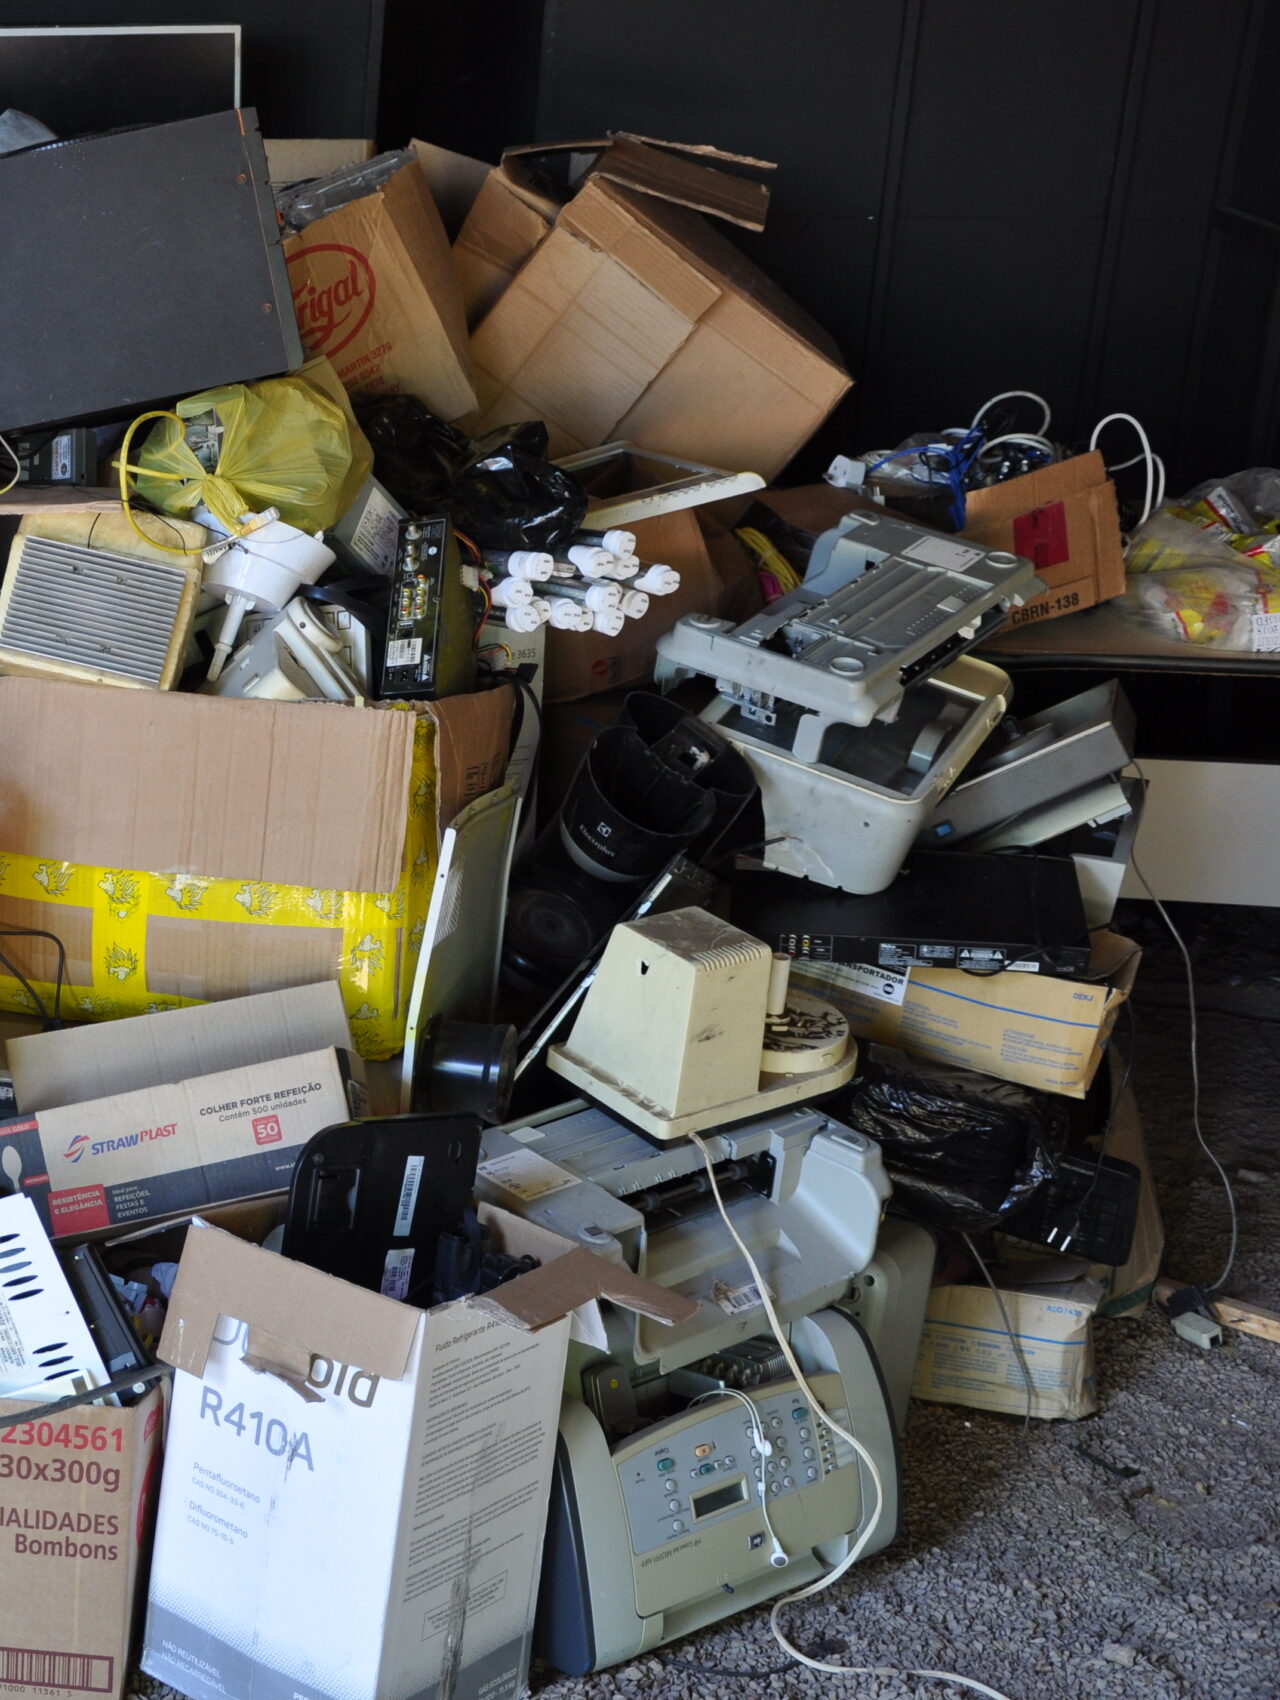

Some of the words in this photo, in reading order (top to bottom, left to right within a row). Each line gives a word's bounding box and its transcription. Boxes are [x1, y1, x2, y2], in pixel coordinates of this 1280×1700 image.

[294, 259, 363, 351] rigal
[1012, 592, 1079, 625] CBRN-138
[517, 648, 536, 659] 3635
[579, 824, 615, 857] Electrolux
[199, 1101, 238, 1117] COLHER
[240, 1093, 272, 1107] FORTE
[273, 1082, 322, 1100] REFEIÇÃO
[219, 1108, 251, 1122] Contém
[252, 1104, 268, 1115] 500
[270, 1096, 307, 1111] unidades
[256, 1122, 279, 1138] 50
[52, 1190, 100, 1207] RESISTÊNCIA
[61, 1197, 103, 1214] ELEGÂNCIA
[115, 1201, 138, 1211] FESTAS
[117, 1206, 148, 1218] EVENTOS
[200, 1385, 315, 1472] R410A
[193, 1462, 260, 1504] Pentafluoroetano
[189, 1500, 248, 1539] Difluorometano
[14, 1533, 118, 1561] Bombons
